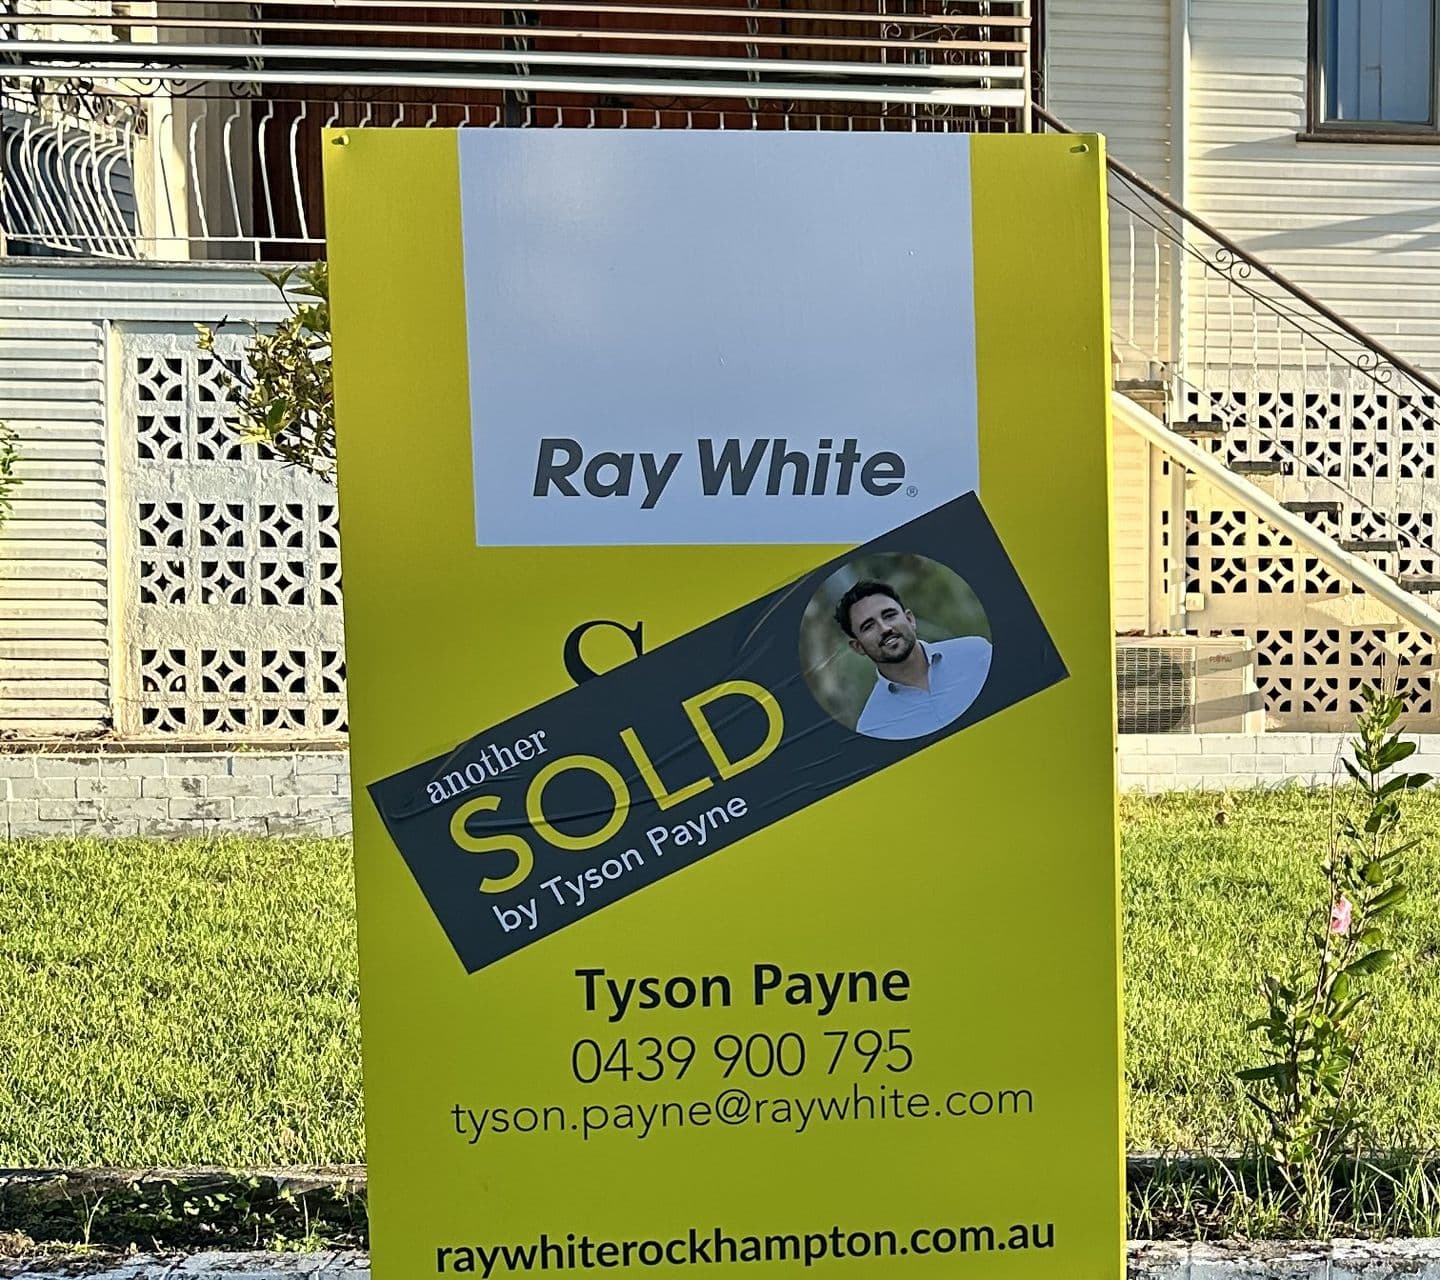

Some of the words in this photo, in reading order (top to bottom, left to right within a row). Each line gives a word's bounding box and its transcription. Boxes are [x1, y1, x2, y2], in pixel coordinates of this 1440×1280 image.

[533, 437, 682, 510] Ray
[696, 437, 906, 498] White
[425, 725, 550, 806] another
[449, 678, 786, 895] SOLD
[492, 898, 538, 935] by
[540, 843, 645, 911] Tyson
[646, 792, 750, 857] Payne
[575, 966, 732, 1022] Tyson
[753, 962, 910, 1020] Payne
[572, 1034, 696, 1084] 0439
[714, 1032, 807, 1079] 900
[823, 1029, 914, 1075] 795
[451, 1083, 1034, 1145] tyson.payne@raywhite.com
[435, 1219, 1056, 1279] raywhiterockhampton.com.au
